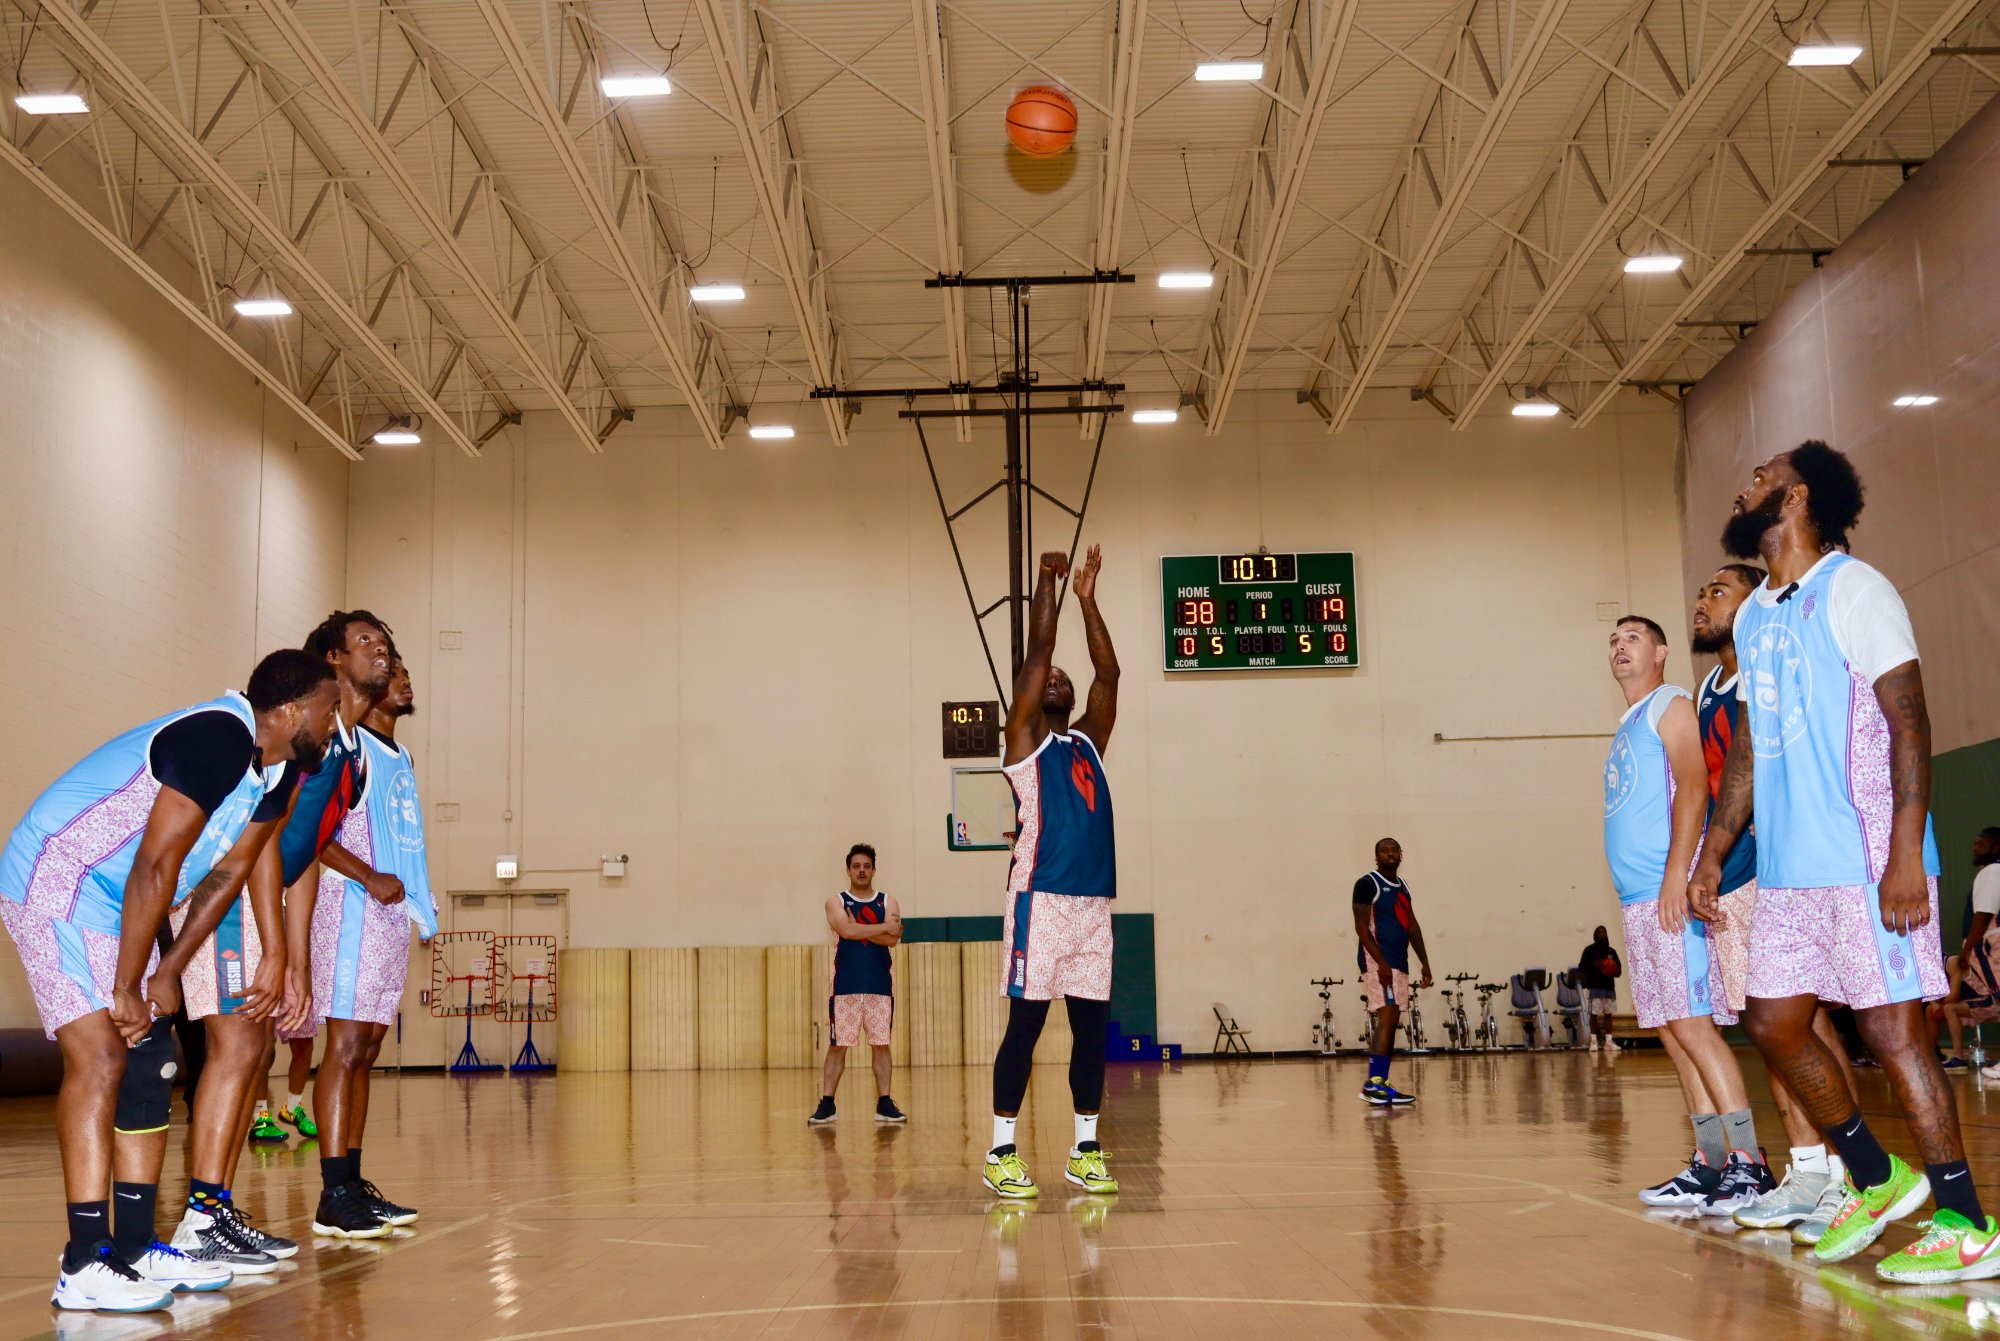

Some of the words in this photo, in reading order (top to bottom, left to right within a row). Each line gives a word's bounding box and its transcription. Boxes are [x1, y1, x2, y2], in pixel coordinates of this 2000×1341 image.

[1232, 557, 1277, 581] 10.7
[1178, 586, 1210, 598] HOME
[1246, 591, 1273, 600] PERIOD
[1305, 583, 1342, 596] GUEST
[1184, 601, 1214, 625] 38
[1322, 598, 1344, 620] 19
[1173, 627, 1198, 636] FOULS
[1206, 627, 1227, 636] T.O.L.
[1234, 626, 1263, 635] PLAYER
[1267, 626, 1287, 634] FOUL
[1294, 625, 1315, 633] T.O.L.
[1323, 624, 1348, 632] FOULS
[1183, 637, 1195, 656] 0
[1211, 636, 1224, 655] 5
[1299, 634, 1312, 653] 5
[1333, 634, 1345, 652] 0
[1174, 659, 1199, 668] SCORE
[1249, 657, 1276, 666] MATCH
[1324, 656, 1349, 664] SCORE
[952, 707, 983, 723] 10.7
[226, 961, 242, 997] MISSIO
[337, 959, 353, 1007] KANHA
[1131, 1039, 1140, 1051] 3
[1162, 1048, 1171, 1060] 5
